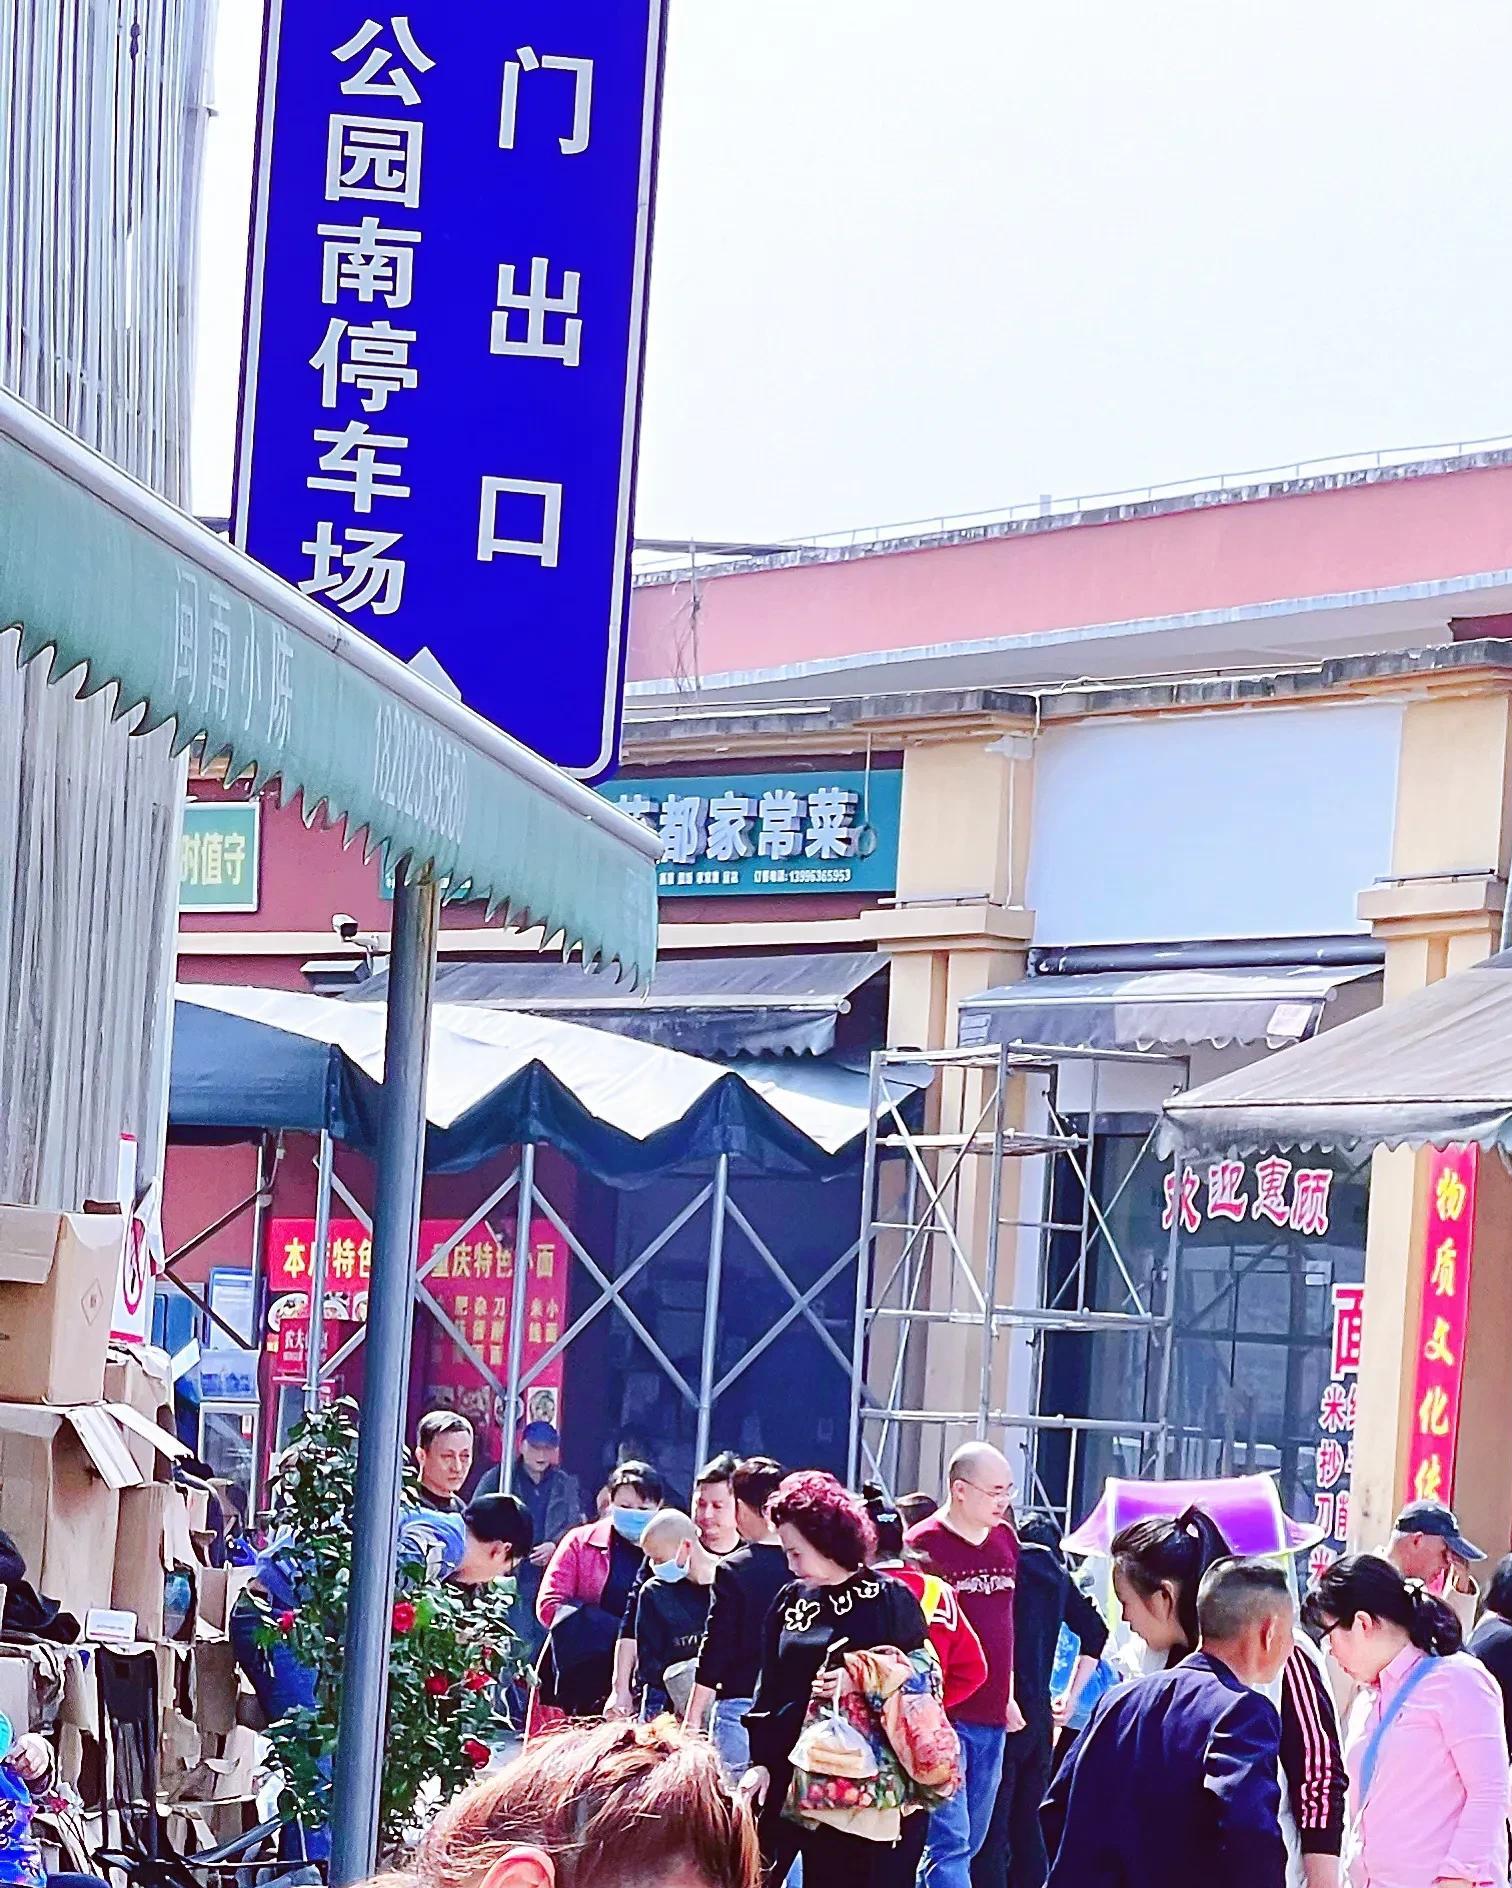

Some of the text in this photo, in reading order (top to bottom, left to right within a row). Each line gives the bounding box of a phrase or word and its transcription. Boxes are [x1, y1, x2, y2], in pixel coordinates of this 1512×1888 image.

[298, 15, 436, 616] 公园南停车场
[477, 45, 594, 568] 门出口
[430, 1241, 556, 1279] 重庆特色面
[1316, 1438, 1353, 1489] 抄
